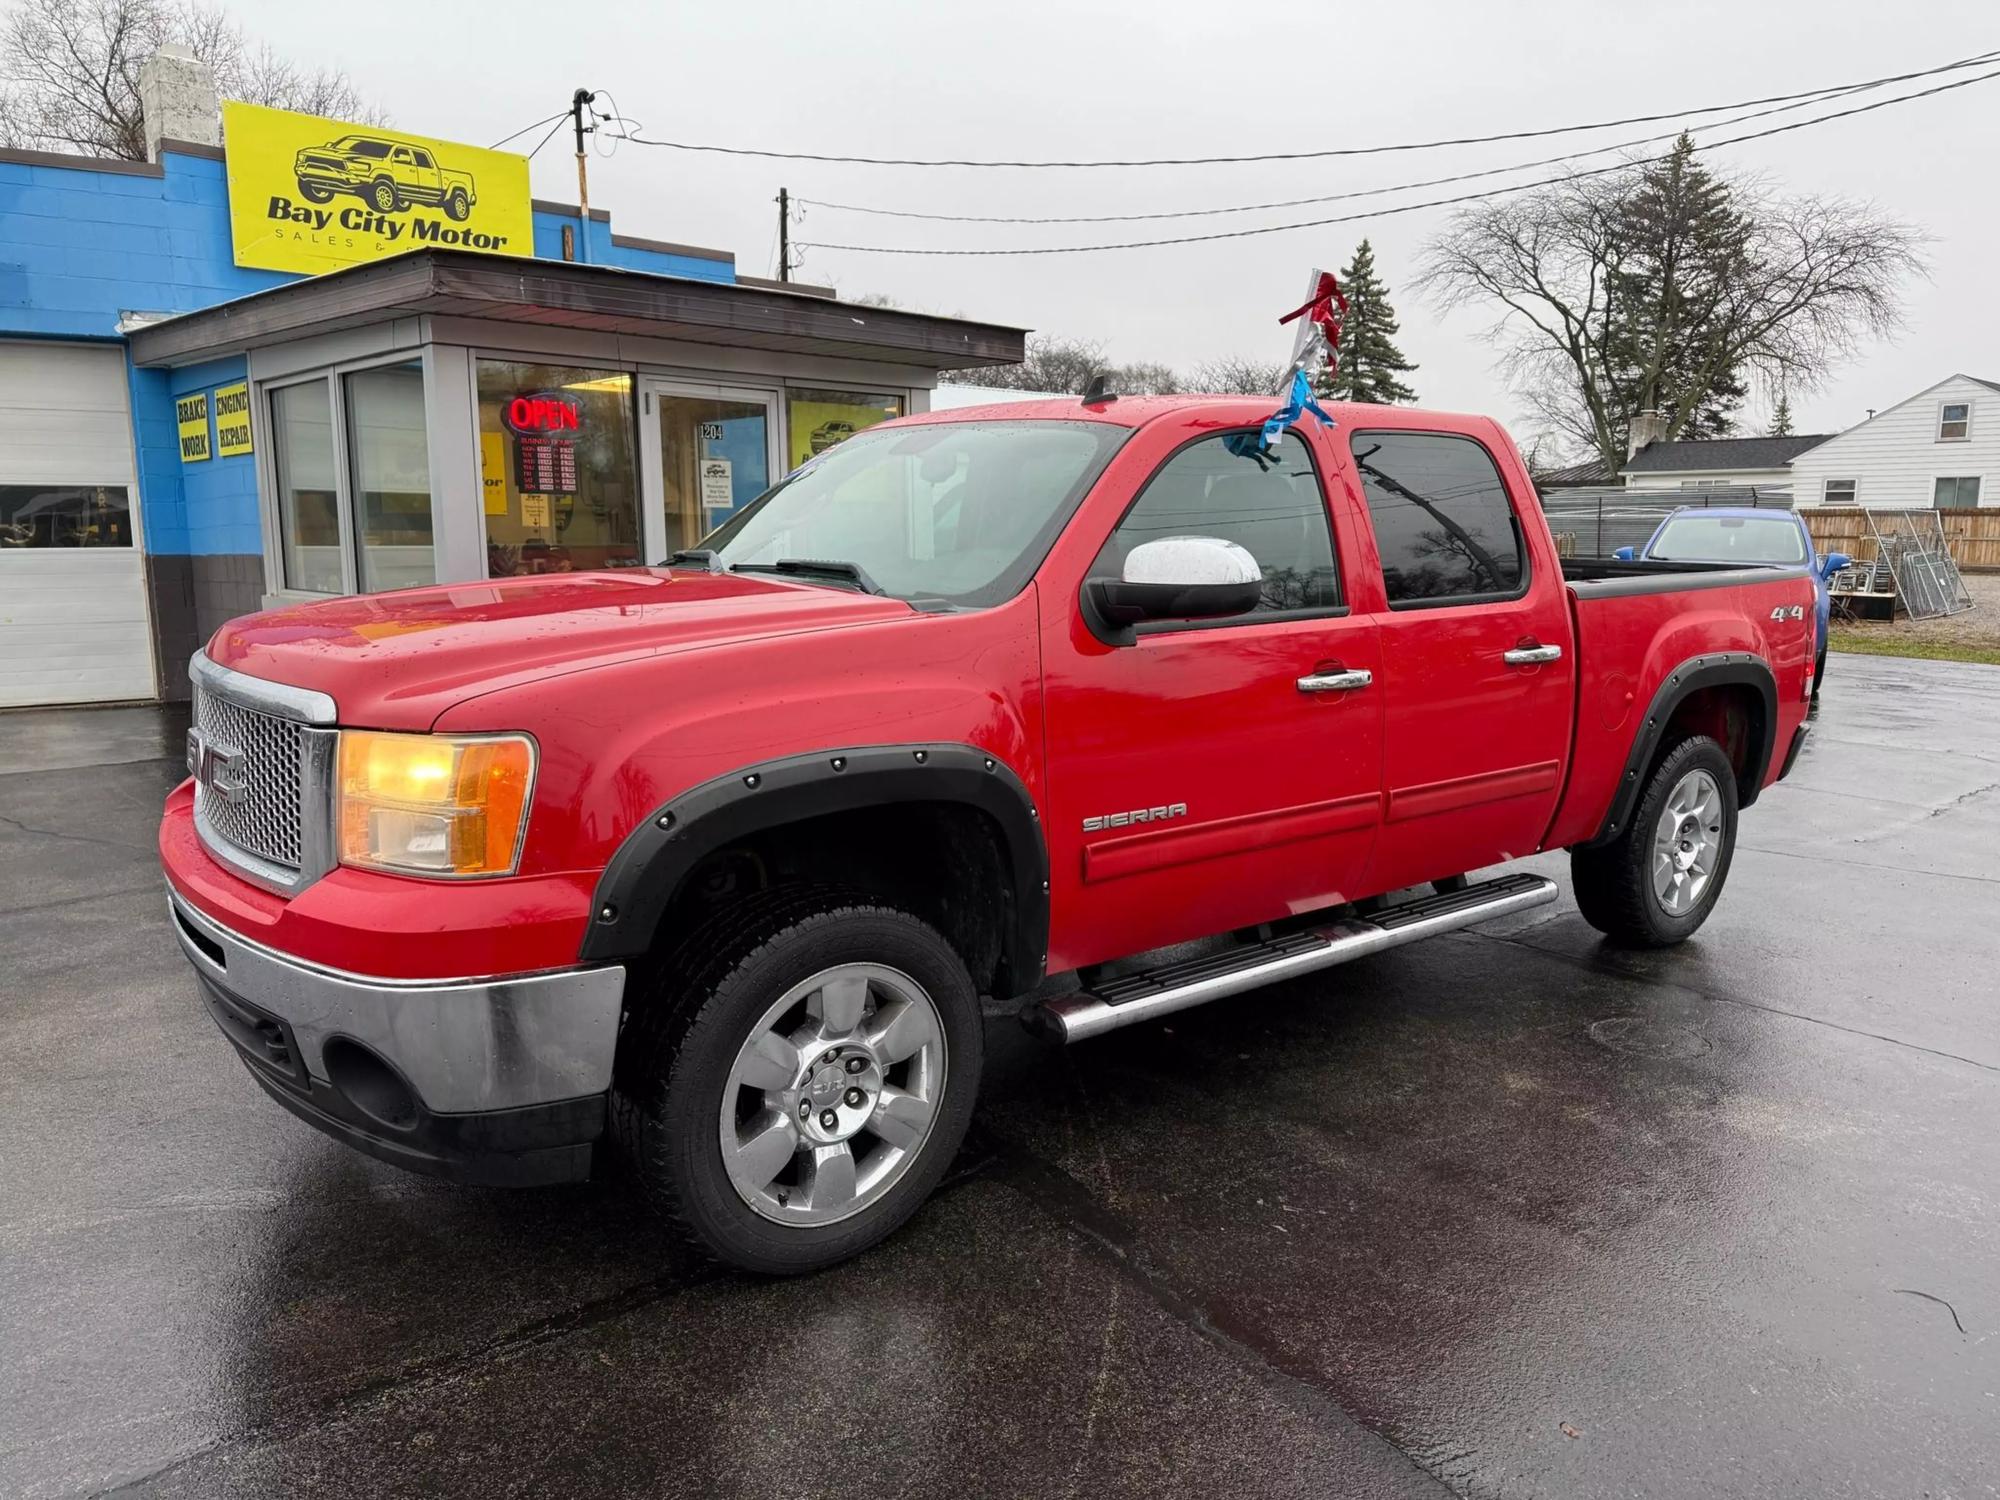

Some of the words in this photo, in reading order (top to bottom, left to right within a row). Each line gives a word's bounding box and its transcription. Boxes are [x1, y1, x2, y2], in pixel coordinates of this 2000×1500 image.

[267, 196, 333, 231] Bay
[339, 207, 406, 241] City
[411, 218, 508, 250] Motor
[275, 228, 354, 248] SALES
[375, 242, 386, 252] &
[177, 397, 206, 424] BRAKE
[216, 391, 248, 416] ENGINE
[510, 398, 578, 431] OPEN
[219, 424, 250, 448] REPAIR
[700, 424, 723, 439] 1204
[181, 434, 207, 457] WORK
[1083, 802, 1187, 832] SIERRA
